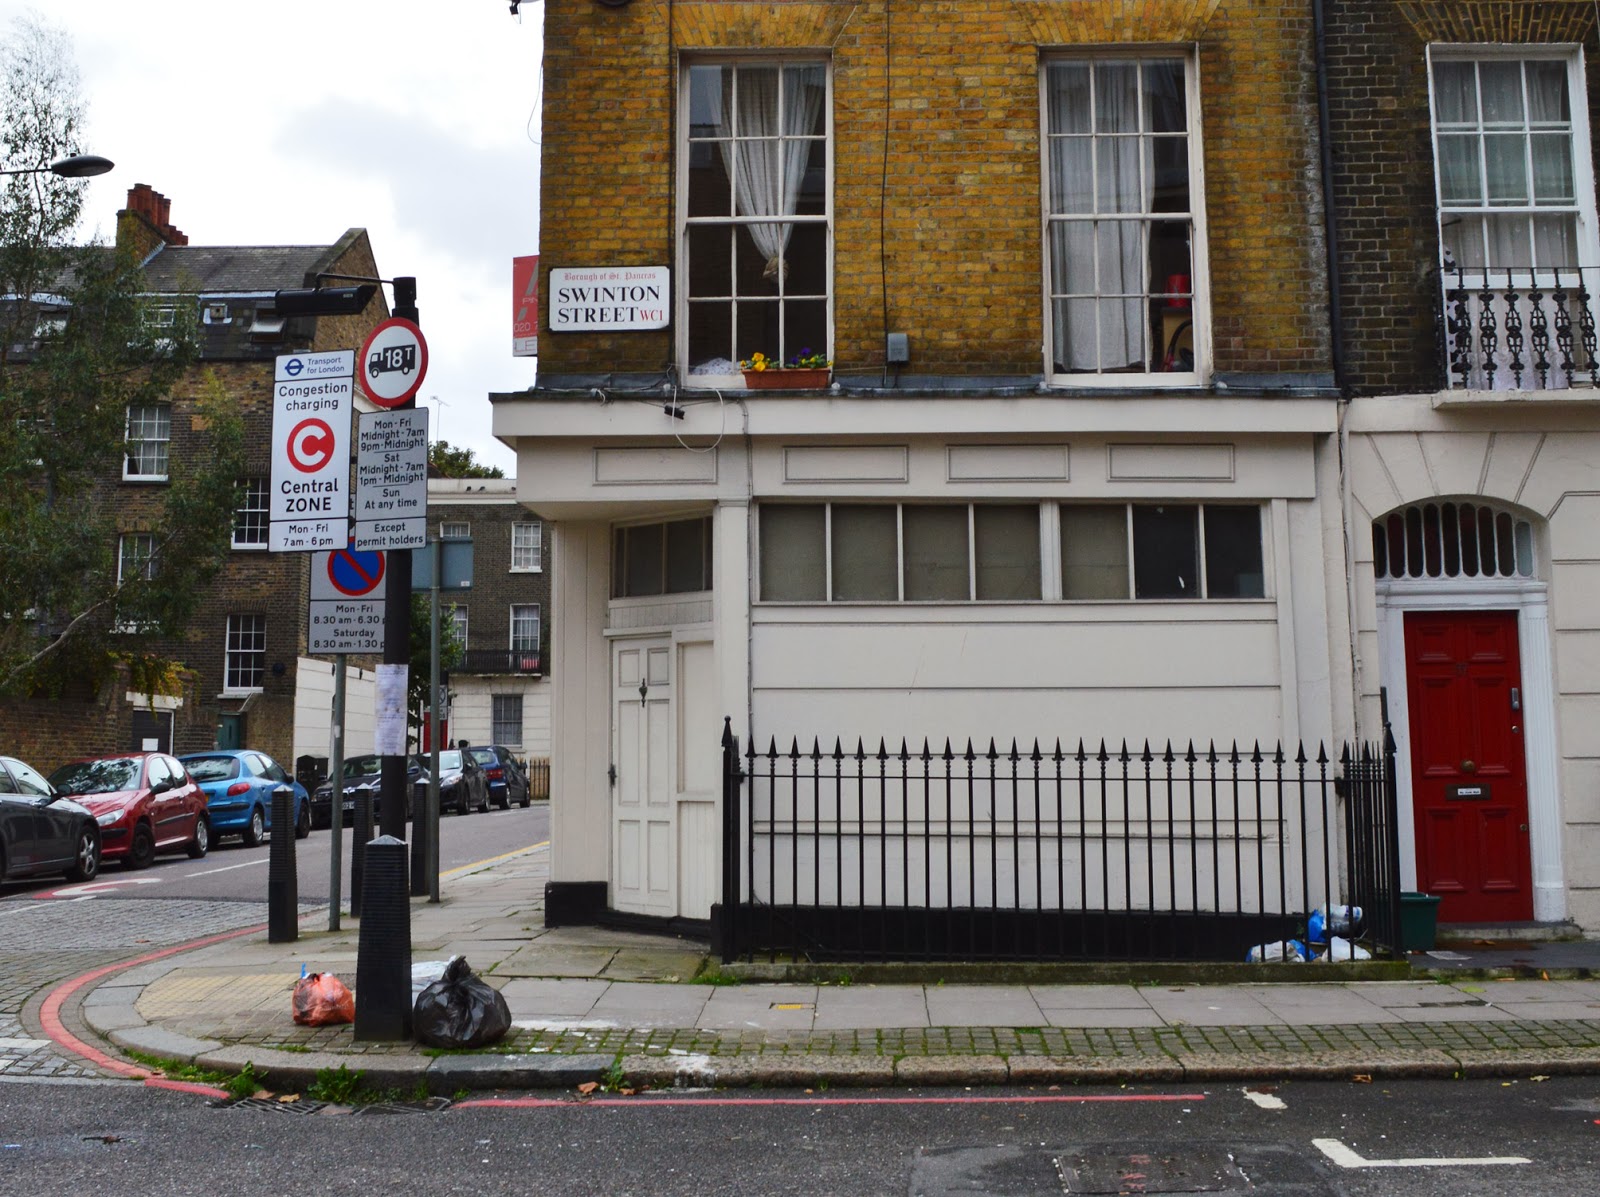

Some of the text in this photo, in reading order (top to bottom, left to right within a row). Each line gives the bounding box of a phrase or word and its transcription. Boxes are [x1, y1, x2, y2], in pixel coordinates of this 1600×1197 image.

[563, 272, 598, 281] Borough
[599, 272, 607, 280] of
[625, 271, 656, 280] Pancras
[558, 286, 660, 303] SWINTON
[557, 306, 663, 323] STREET WC1
[513, 322, 531, 333] 020
[308, 357, 342, 366] Transport
[385, 348, 403, 369] 18
[279, 383, 348, 397] Congestion
[286, 398, 339, 411] charging
[374, 420, 393, 430] Mon
[400, 418, 411, 427] Fri
[361, 429, 400, 441] Midnight
[406, 428, 425, 437] 7am
[384, 453, 400, 463] Sat
[360, 464, 399, 475] Midnight
[405, 462, 424, 472] 7am
[383, 472, 424, 484] Midnight
[281, 478, 338, 494] Central
[382, 488, 400, 498] Sun
[286, 497, 332, 512] ZONE
[364, 500, 375, 509] At
[378, 501, 394, 510] any
[397, 498, 418, 508] time
[288, 525, 309, 533] Mon
[316, 523, 329, 532] Fri
[374, 522, 406, 533] Except
[356, 534, 424, 548] permit holders
[333, 629, 375, 638] Saturday
